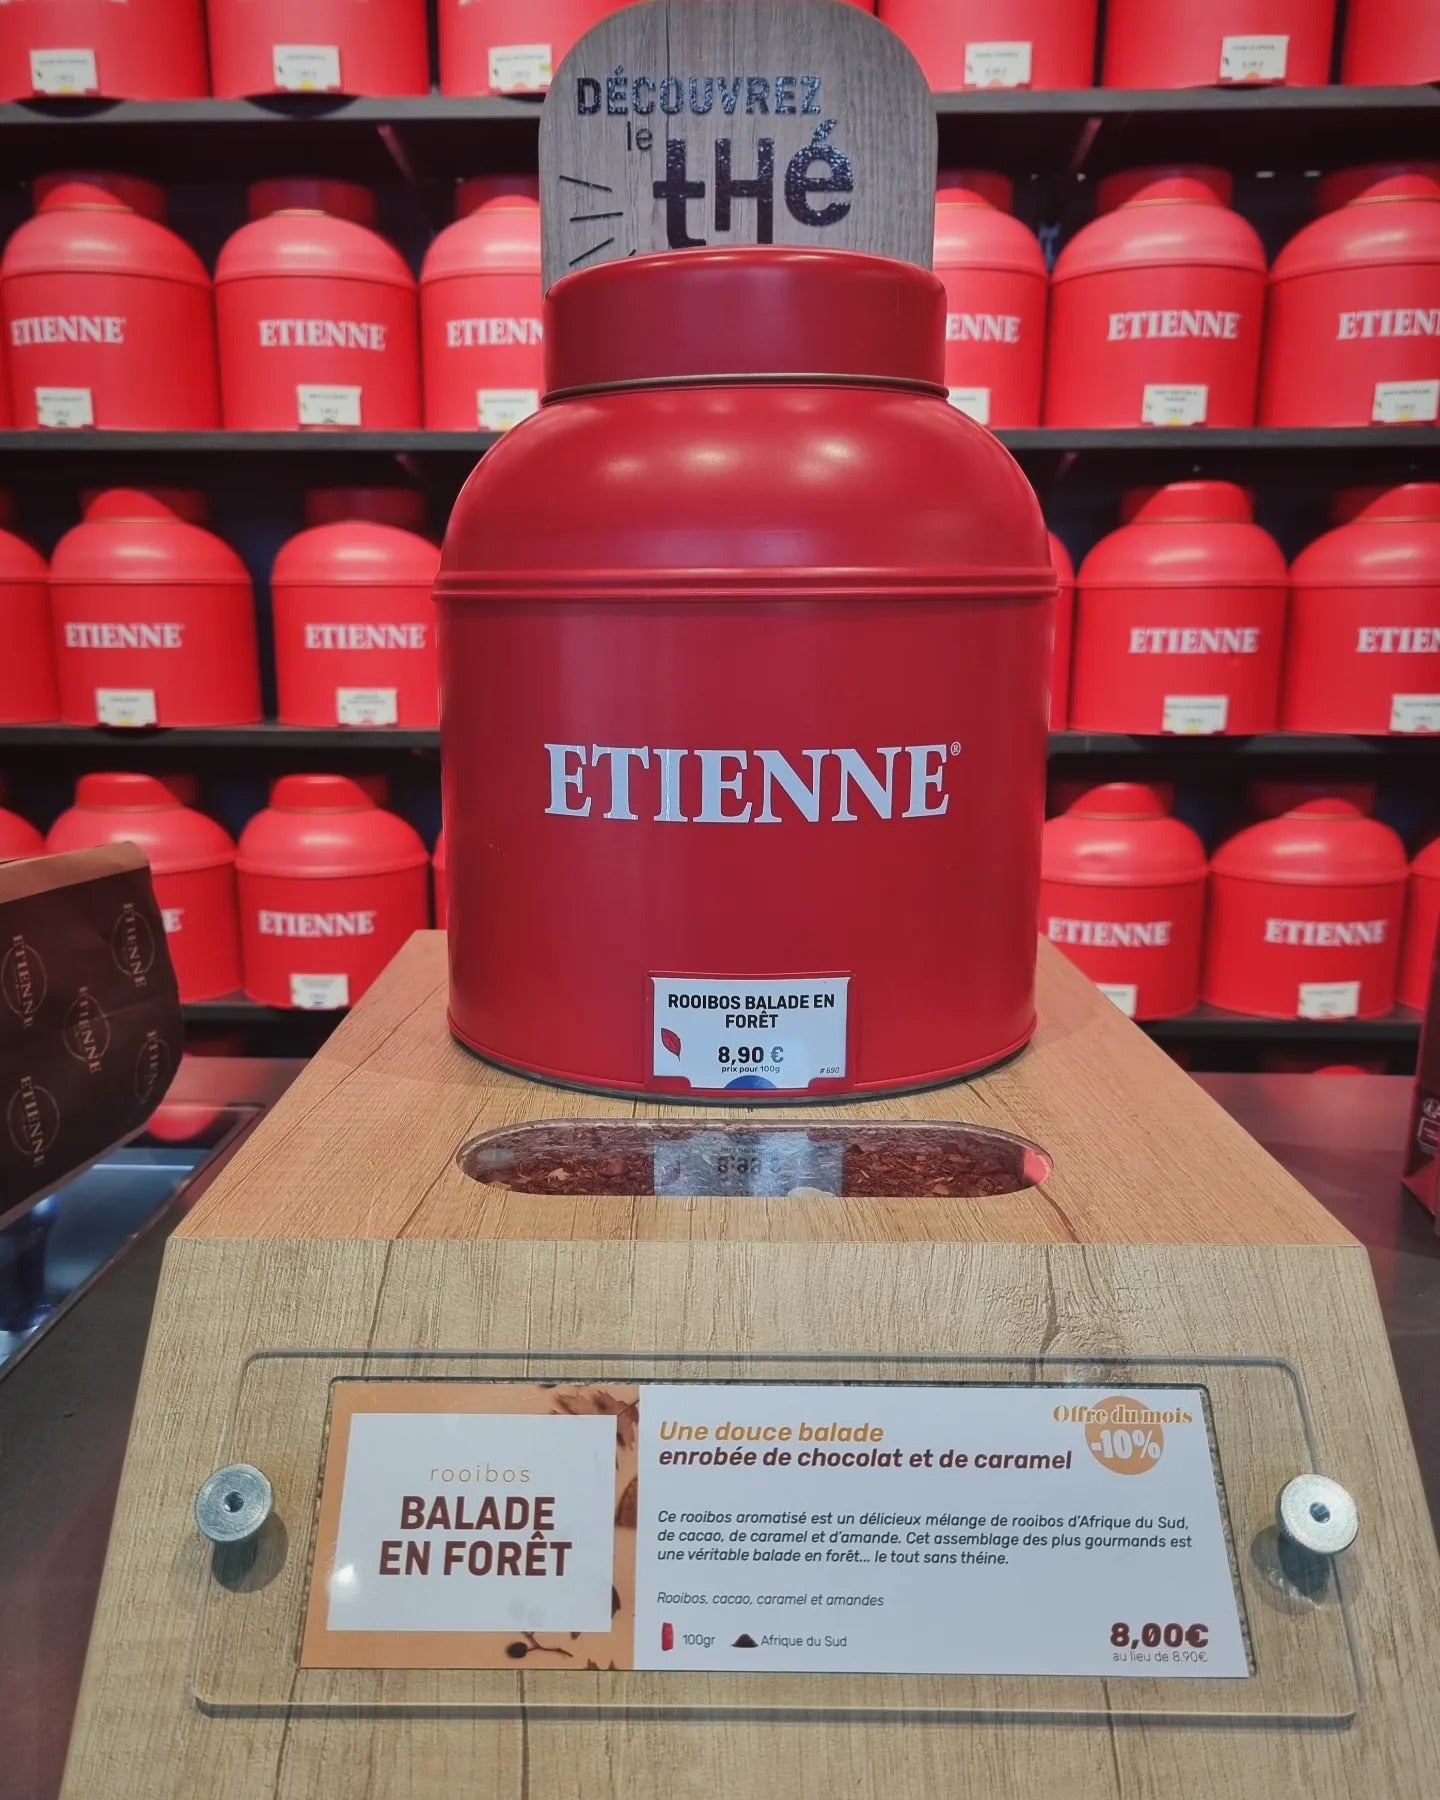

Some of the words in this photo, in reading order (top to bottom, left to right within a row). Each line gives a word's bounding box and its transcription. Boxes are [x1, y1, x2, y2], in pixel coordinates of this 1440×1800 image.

[577, 65, 822, 115] DÉCOUVREZ
[626, 120, 653, 151] le
[10, 314, 122, 347] ETIENNE
[258, 317, 387, 351] ETIENNE
[1107, 309, 1240, 342] ETIENNE
[1335, 308, 1440, 341] ETIEN
[65, 622, 182, 649] ETIENNE
[304, 623, 426, 649] ETIENNE
[1129, 626, 1260, 653] ETIENNE
[257, 909, 376, 938] ETIENNE
[1048, 916, 1171, 947] ETIENNE
[1264, 916, 1387, 947] ETIENNE
[123, 901, 147, 988] ETIENNE
[12, 933, 35, 1029] ETIENNE
[668, 993, 741, 1010] ROOIBOS
[745, 993, 809, 1010] BALADE
[813, 993, 835, 1008] EN
[78, 985, 101, 1074] ETIENNE
[725, 1010, 779, 1029] FORÊT
[718, 1046, 765, 1066] 8,90
[770, 1046, 784, 1063] €
[721, 1064, 738, 1074] prix
[739, 1066, 758, 1074] pour
[760, 1065, 781, 1074] 100g
[660, 1421, 709, 1441] Une
[715, 1421, 793, 1442] douce
[799, 1422, 885, 1443] balade
[1091, 1429, 1161, 1460] -10%
[659, 1446, 757, 1466] enrobée
[762, 1447, 792, 1466] de
[797, 1448, 903, 1468] chocolat
[909, 1449, 934, 1468] et
[939, 1449, 969, 1469] de
[974, 1450, 1073, 1470] caramel
[430, 1462, 531, 1483] rooibos
[400, 1495, 555, 1531] BALADE
[658, 1510, 676, 1523] Ce
[680, 1510, 732, 1524] rooibos
[736, 1511, 807, 1525] aromatisé
[811, 1513, 833, 1525] est
[837, 1514, 855, 1525] un
[859, 1512, 921, 1526] délicieux
[925, 1513, 986, 1531] mélange
[990, 1514, 1008, 1527] de
[1012, 1514, 1064, 1528] rooibos
[1135, 1515, 1153, 1528] du
[1158, 1516, 1189, 1530] Sud,
[379, 1540, 431, 1576] EN
[443, 1531, 573, 1577] FORÊT
[658, 1529, 675, 1541] de
[678, 1531, 725, 1544] cacao,
[729, 1530, 747, 1543] de
[750, 1530, 807, 1543] caramel
[811, 1532, 826, 1544] et
[906, 1532, 930, 1545] Cet
[934, 1532, 1019, 1550] assemblage
[1023, 1533, 1048, 1546] des
[1051, 1533, 1081, 1550] plus
[1085, 1534, 1166, 1552] gourmands
[1170, 1536, 1192, 1548] est
[657, 1550, 684, 1561] une
[688, 1547, 750, 1561] véritable
[753, 1548, 801, 1562] balade
[804, 1551, 822, 1562] en
[874, 1550, 887, 1563] le
[890, 1550, 920, 1564] tout
[924, 1553, 957, 1564] sans
[961, 1551, 1009, 1565] théine.
[712, 1594, 753, 1606] cacao,
[756, 1593, 807, 1605] caramel
[811, 1594, 823, 1606] et
[826, 1594, 885, 1607] amandes
[682, 1634, 716, 1649] 100gr
[761, 1635, 803, 1649] Afrique
[806, 1635, 822, 1647] du
[824, 1635, 848, 1648] Sud
[1110, 1622, 1209, 1650] 8,00€
[1112, 1653, 1127, 1662] au
[1130, 1651, 1151, 1662] lieu
[1154, 1651, 1169, 1663] de
